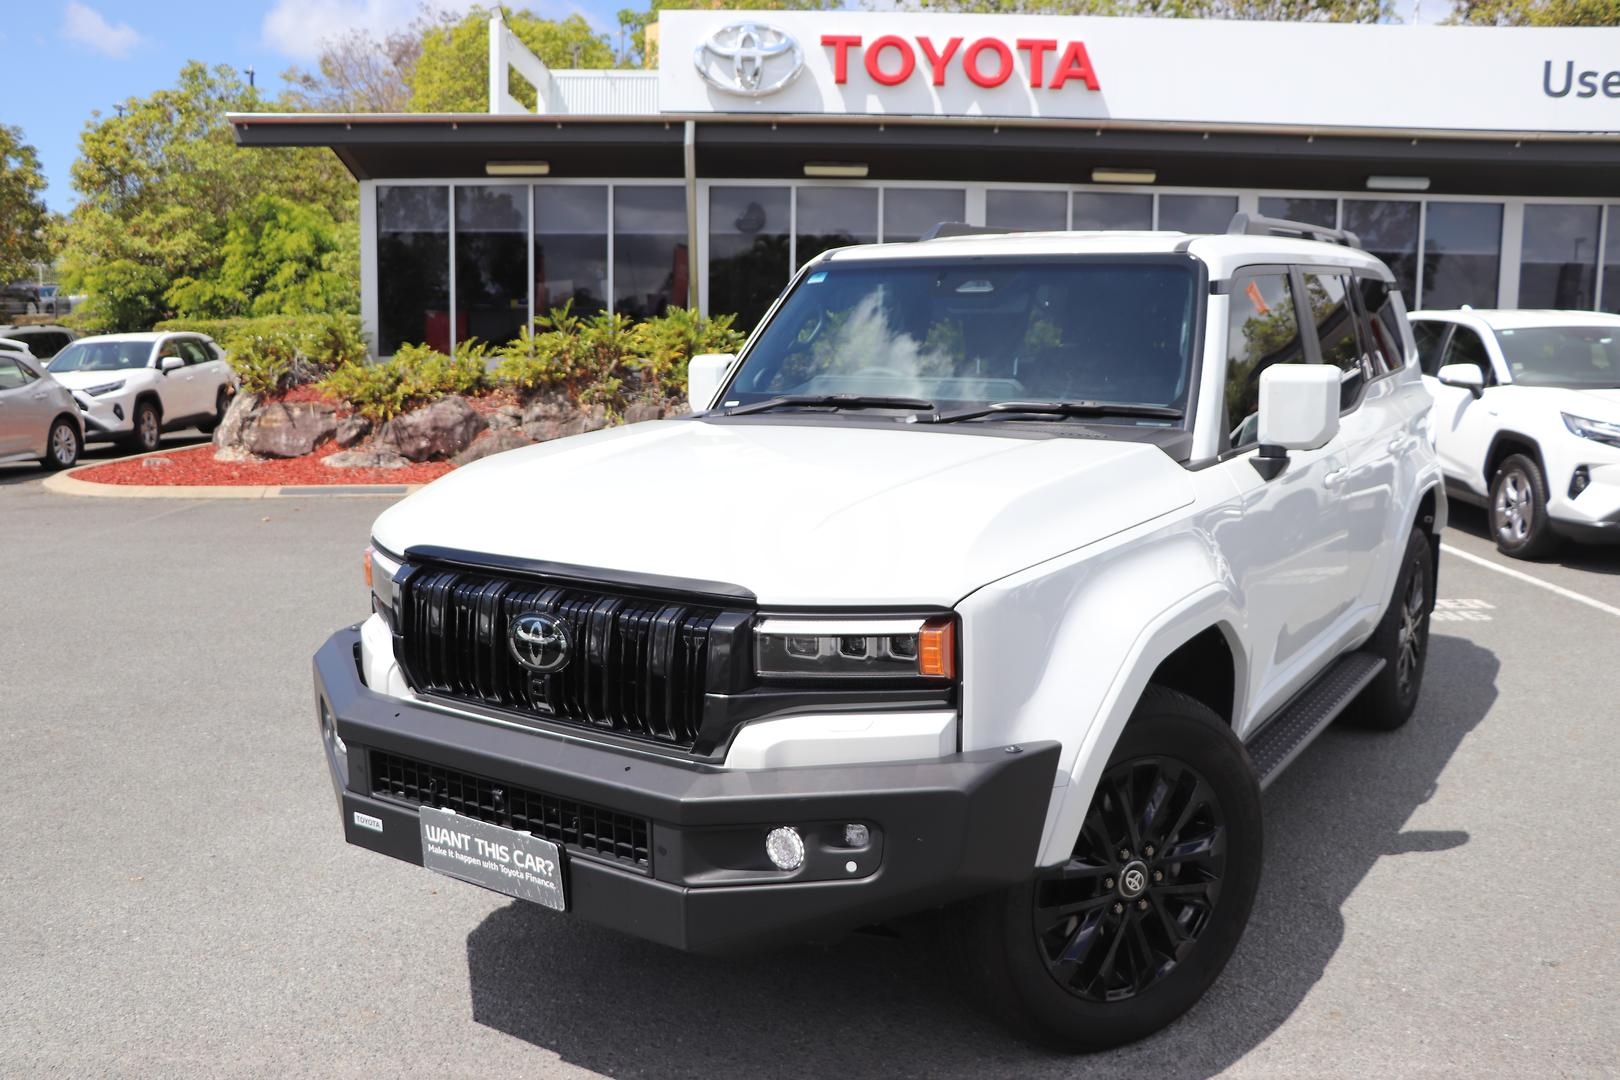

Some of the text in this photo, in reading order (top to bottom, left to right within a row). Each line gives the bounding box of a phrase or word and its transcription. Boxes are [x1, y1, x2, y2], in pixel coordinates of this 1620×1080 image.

[820, 34, 1100, 91] TOYOTA
[355, 814, 381, 828] TOYOTA
[425, 824, 555, 877] WANT THIS CAR?
[428, 844, 557, 890] Make it happen with Toyota Finance.
